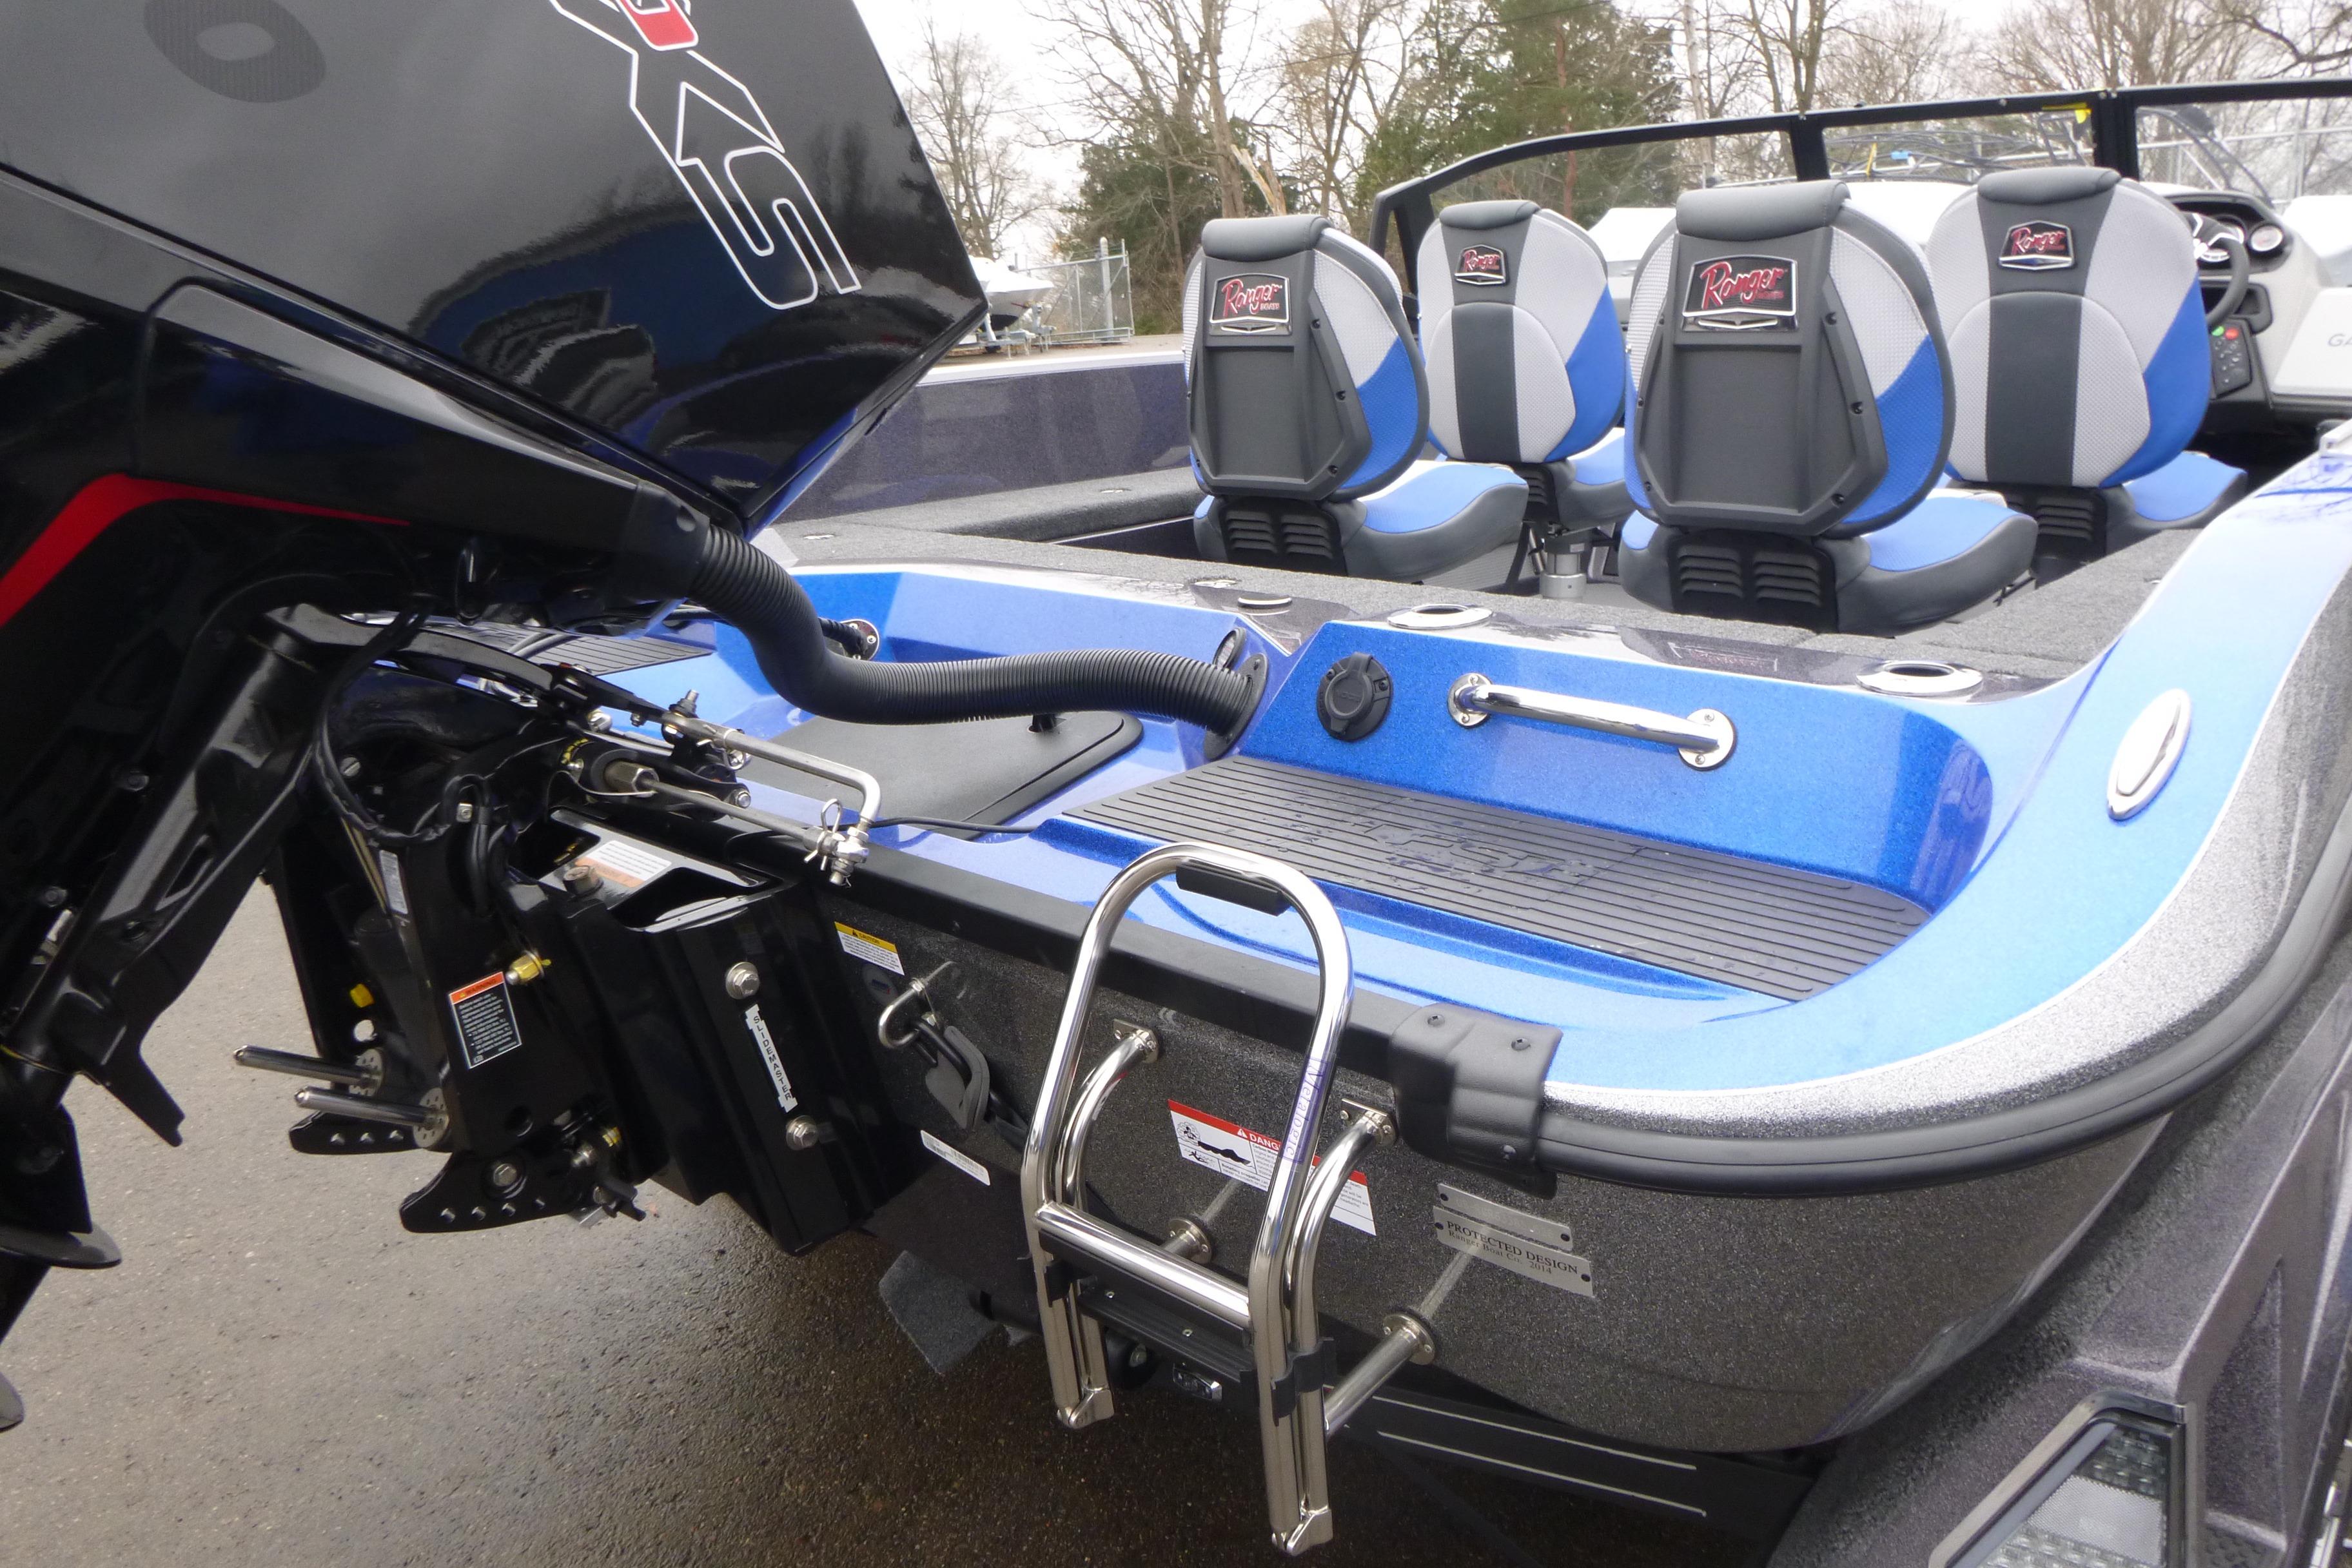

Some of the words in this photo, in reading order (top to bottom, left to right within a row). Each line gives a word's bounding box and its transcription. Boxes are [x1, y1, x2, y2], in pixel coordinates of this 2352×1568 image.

[2011, 227, 2066, 255] Ranger
[1462, 250, 1500, 271] Ranger
[1221, 279, 1280, 317] Ranger
[1700, 261, 1785, 309] Ranger
[859, 932, 880, 945] CAUTION
[466, 977, 497, 995] WARNING
[753, 1015, 792, 1101] SLIDEMASTER
[1286, 1063, 1326, 1157] Metalogic
[1249, 1132, 1281, 1150] DANG
[1446, 1220, 1522, 1256] PROTECTED
[1526, 1251, 1578, 1275] DESIGN
[1448, 1230, 1481, 1248] Ranger
[1483, 1245, 1504, 1257] Boat
[1529, 1260, 1553, 1275] 2014
